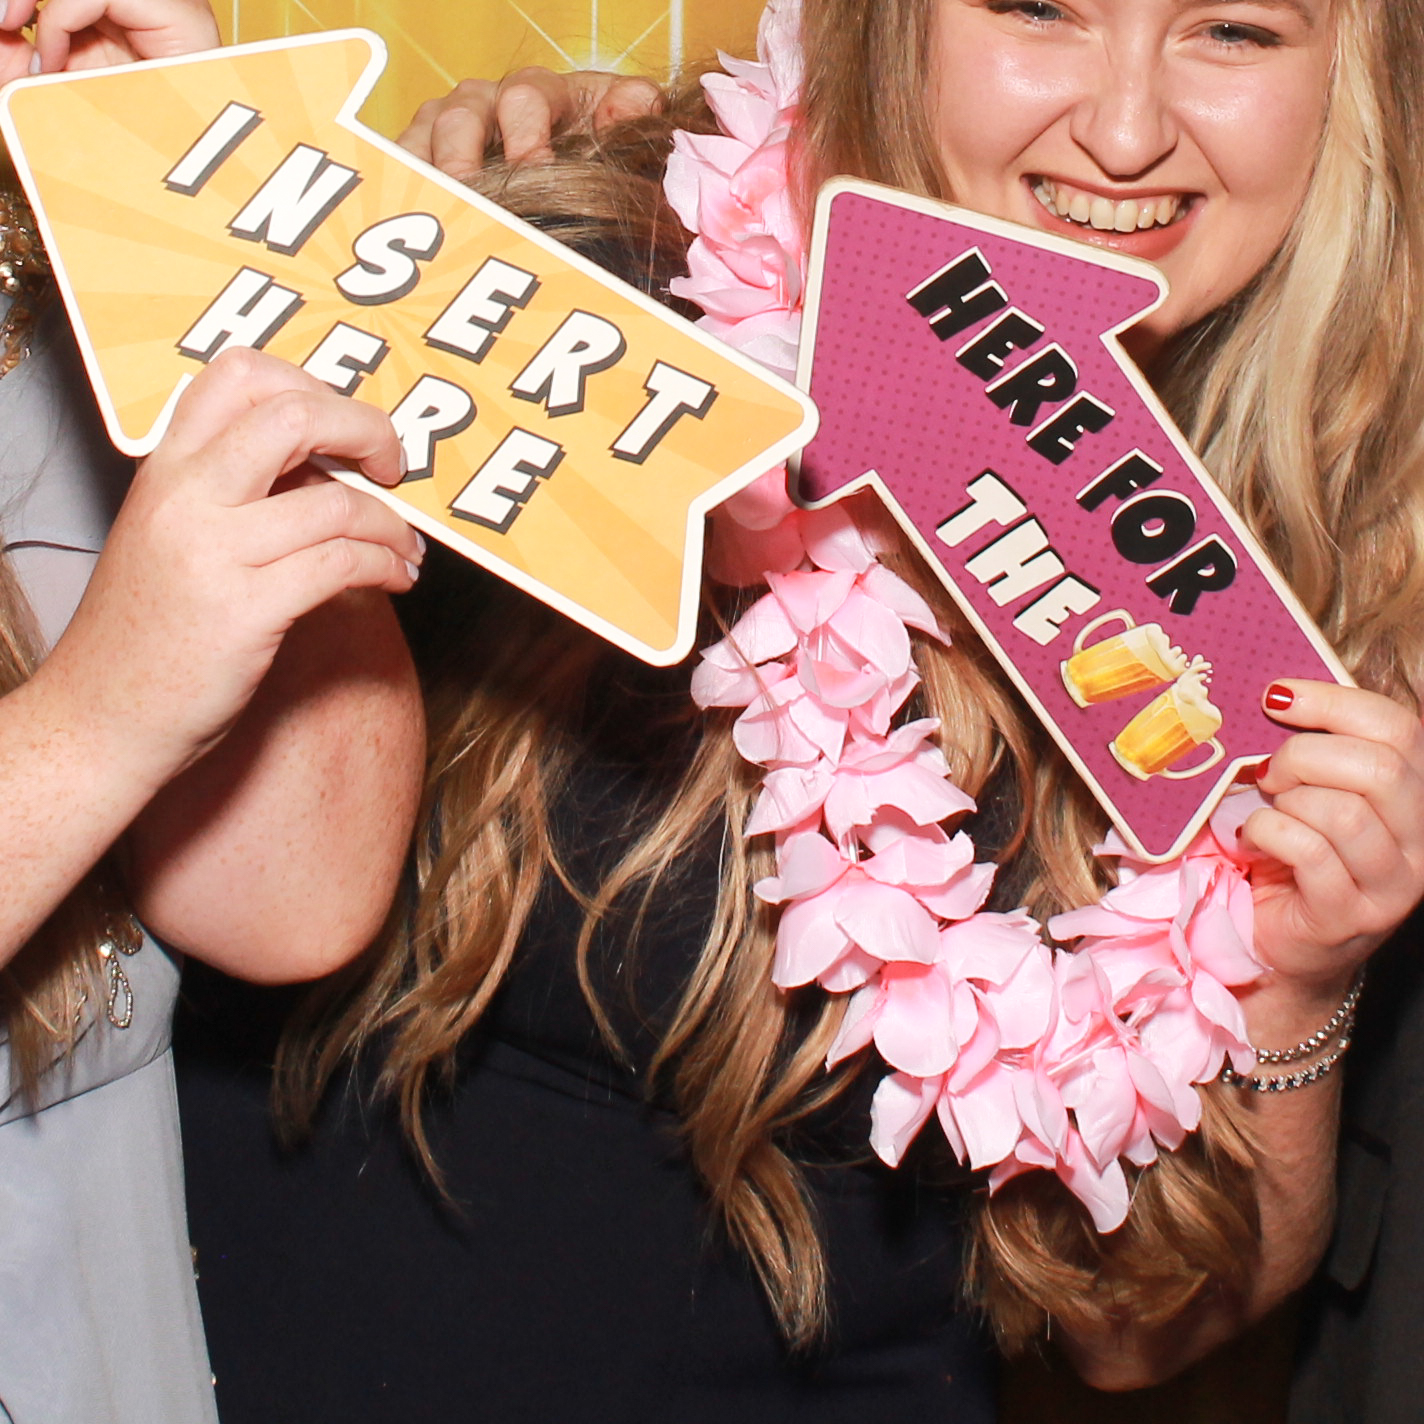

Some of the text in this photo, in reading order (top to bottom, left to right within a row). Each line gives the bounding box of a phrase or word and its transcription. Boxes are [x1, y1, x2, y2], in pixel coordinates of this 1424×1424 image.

[162, 100, 718, 464] INSERT
[905, 244, 1238, 616] HERE FOR
[935, 468, 1102, 646] THE
